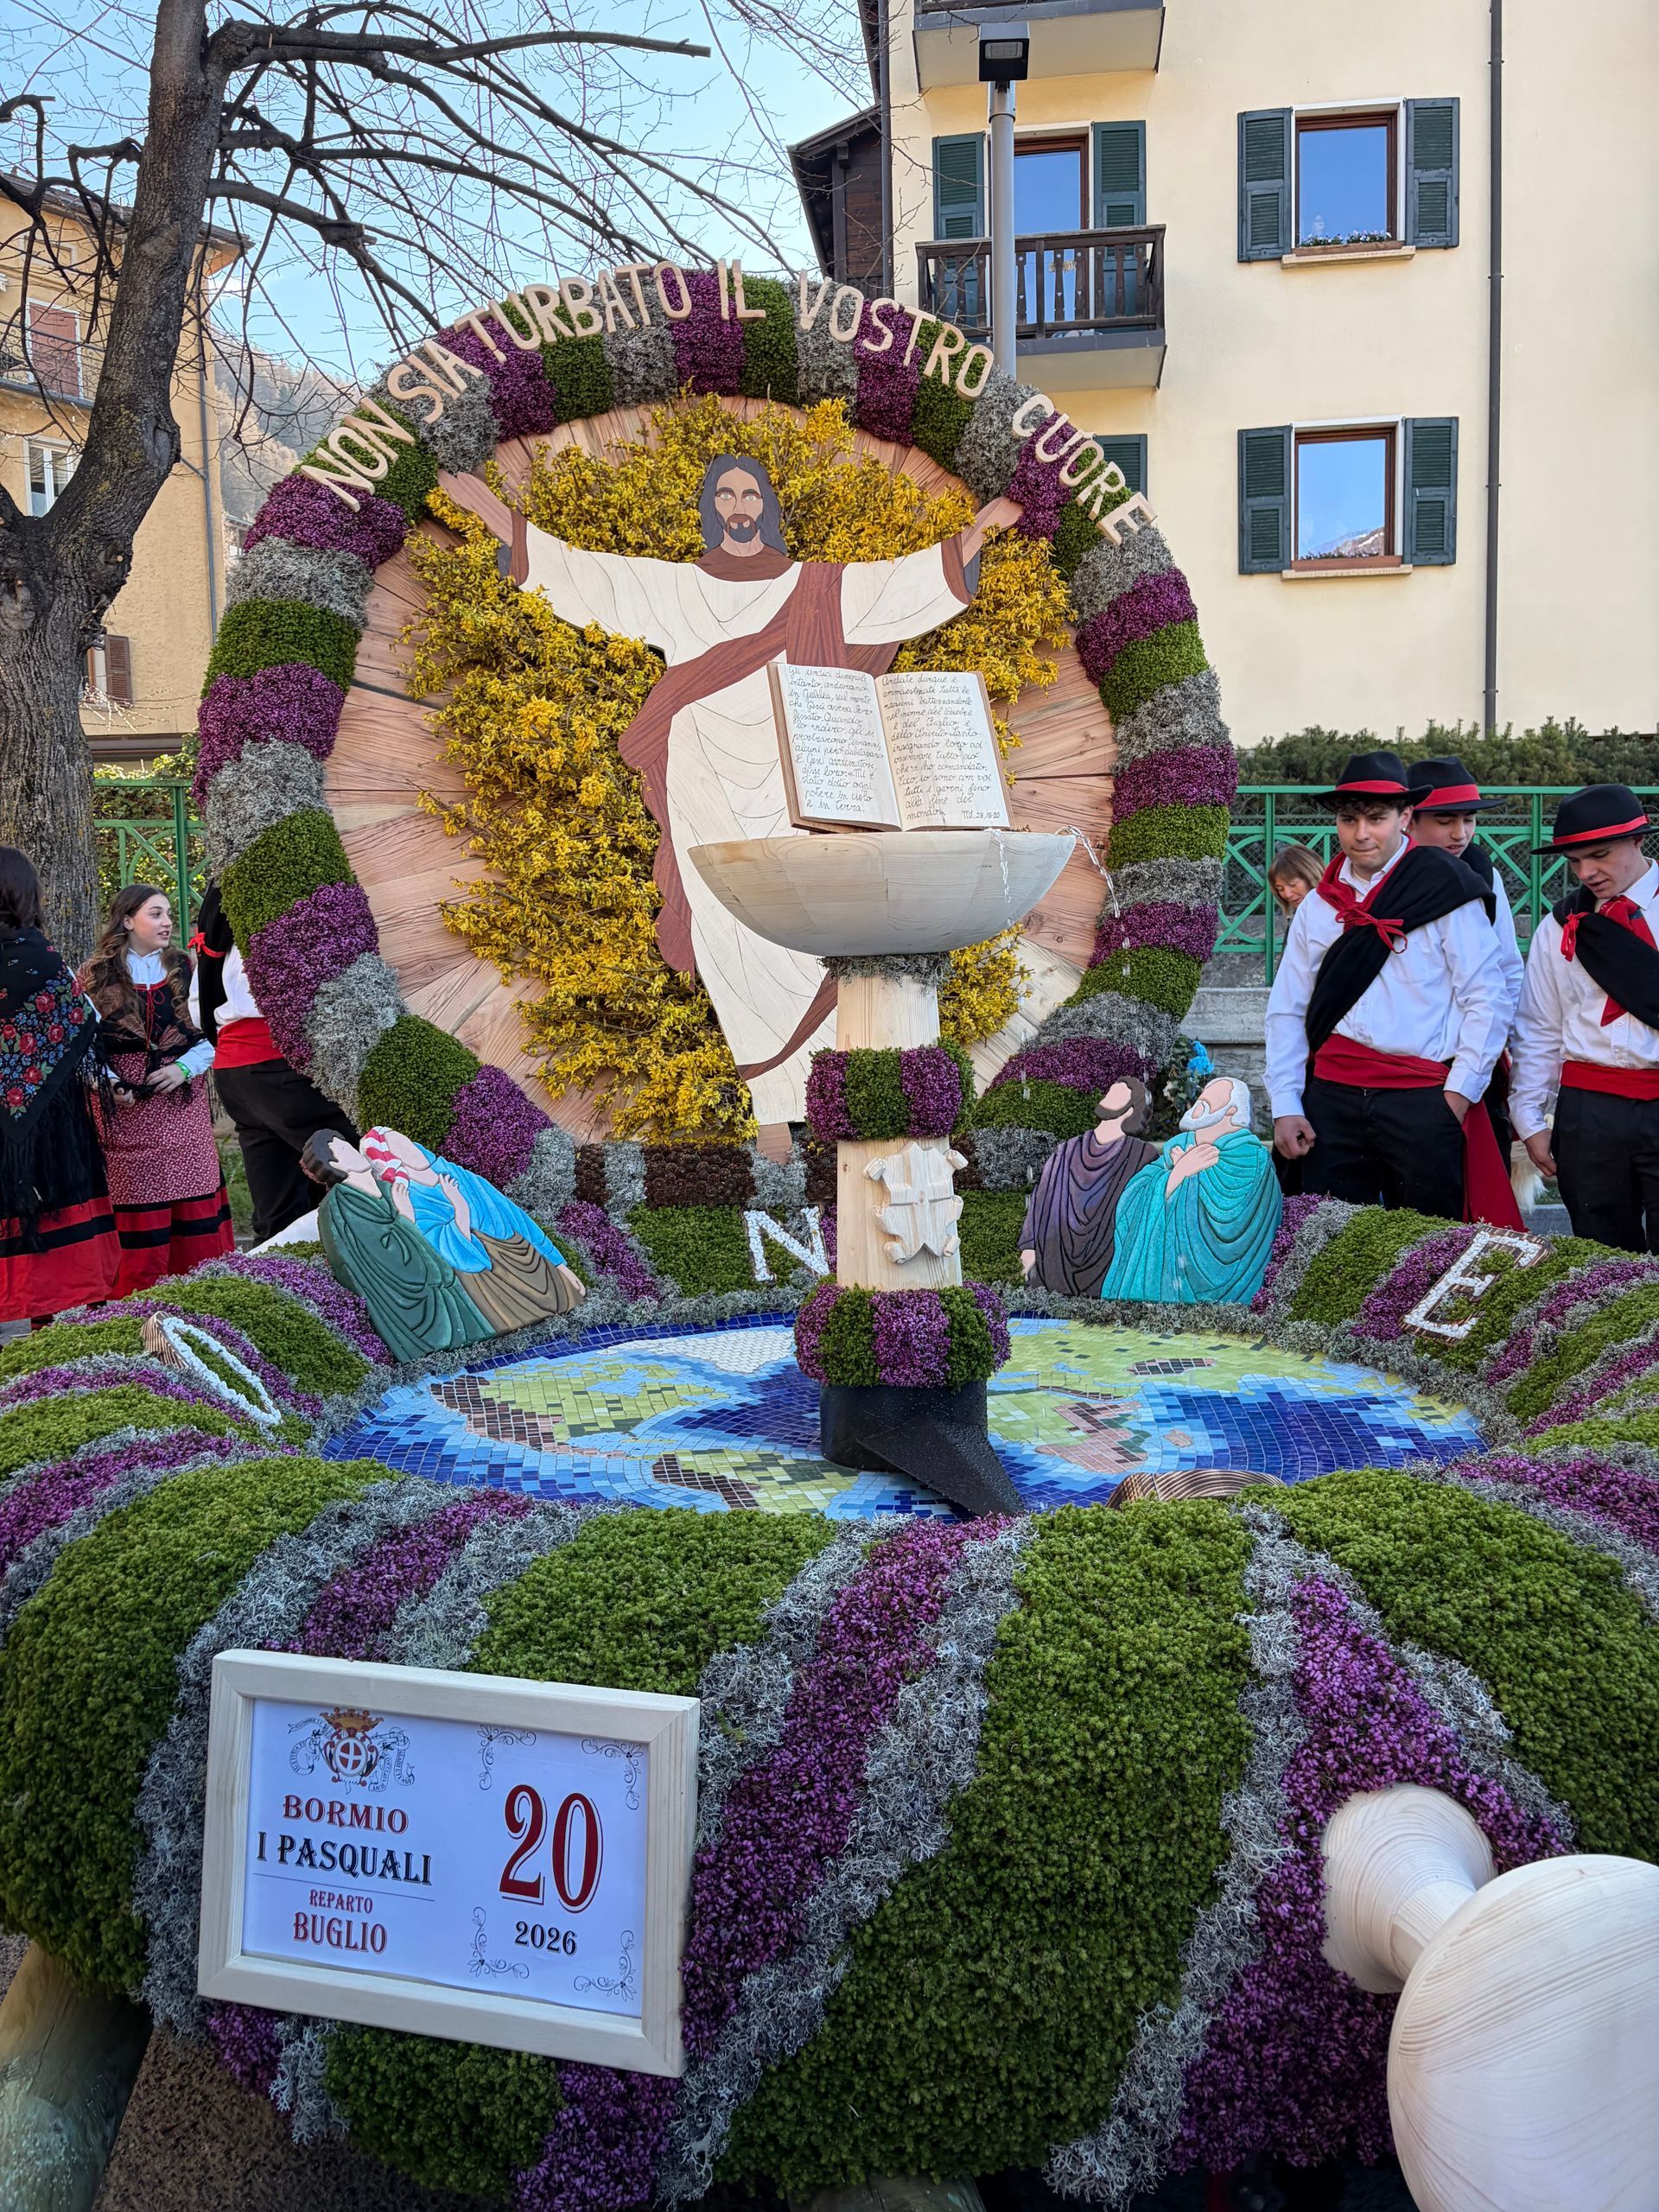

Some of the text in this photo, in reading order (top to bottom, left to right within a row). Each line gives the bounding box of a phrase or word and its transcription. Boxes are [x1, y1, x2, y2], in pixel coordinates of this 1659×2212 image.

[301, 258, 1158, 546] NON SIA TURBATO IL VOSTRO CUORE
[741, 1205, 830, 1283] N
[1401, 1225, 1547, 1343] E
[283, 1794, 410, 1834] BORMIO
[257, 1831, 433, 1885] I PASQUALI
[499, 1783, 604, 1914] 20
[308, 1889, 373, 1914] REPARTO
[293, 1911, 388, 1954] BUGLIO
[514, 1921, 579, 1956] 2026
